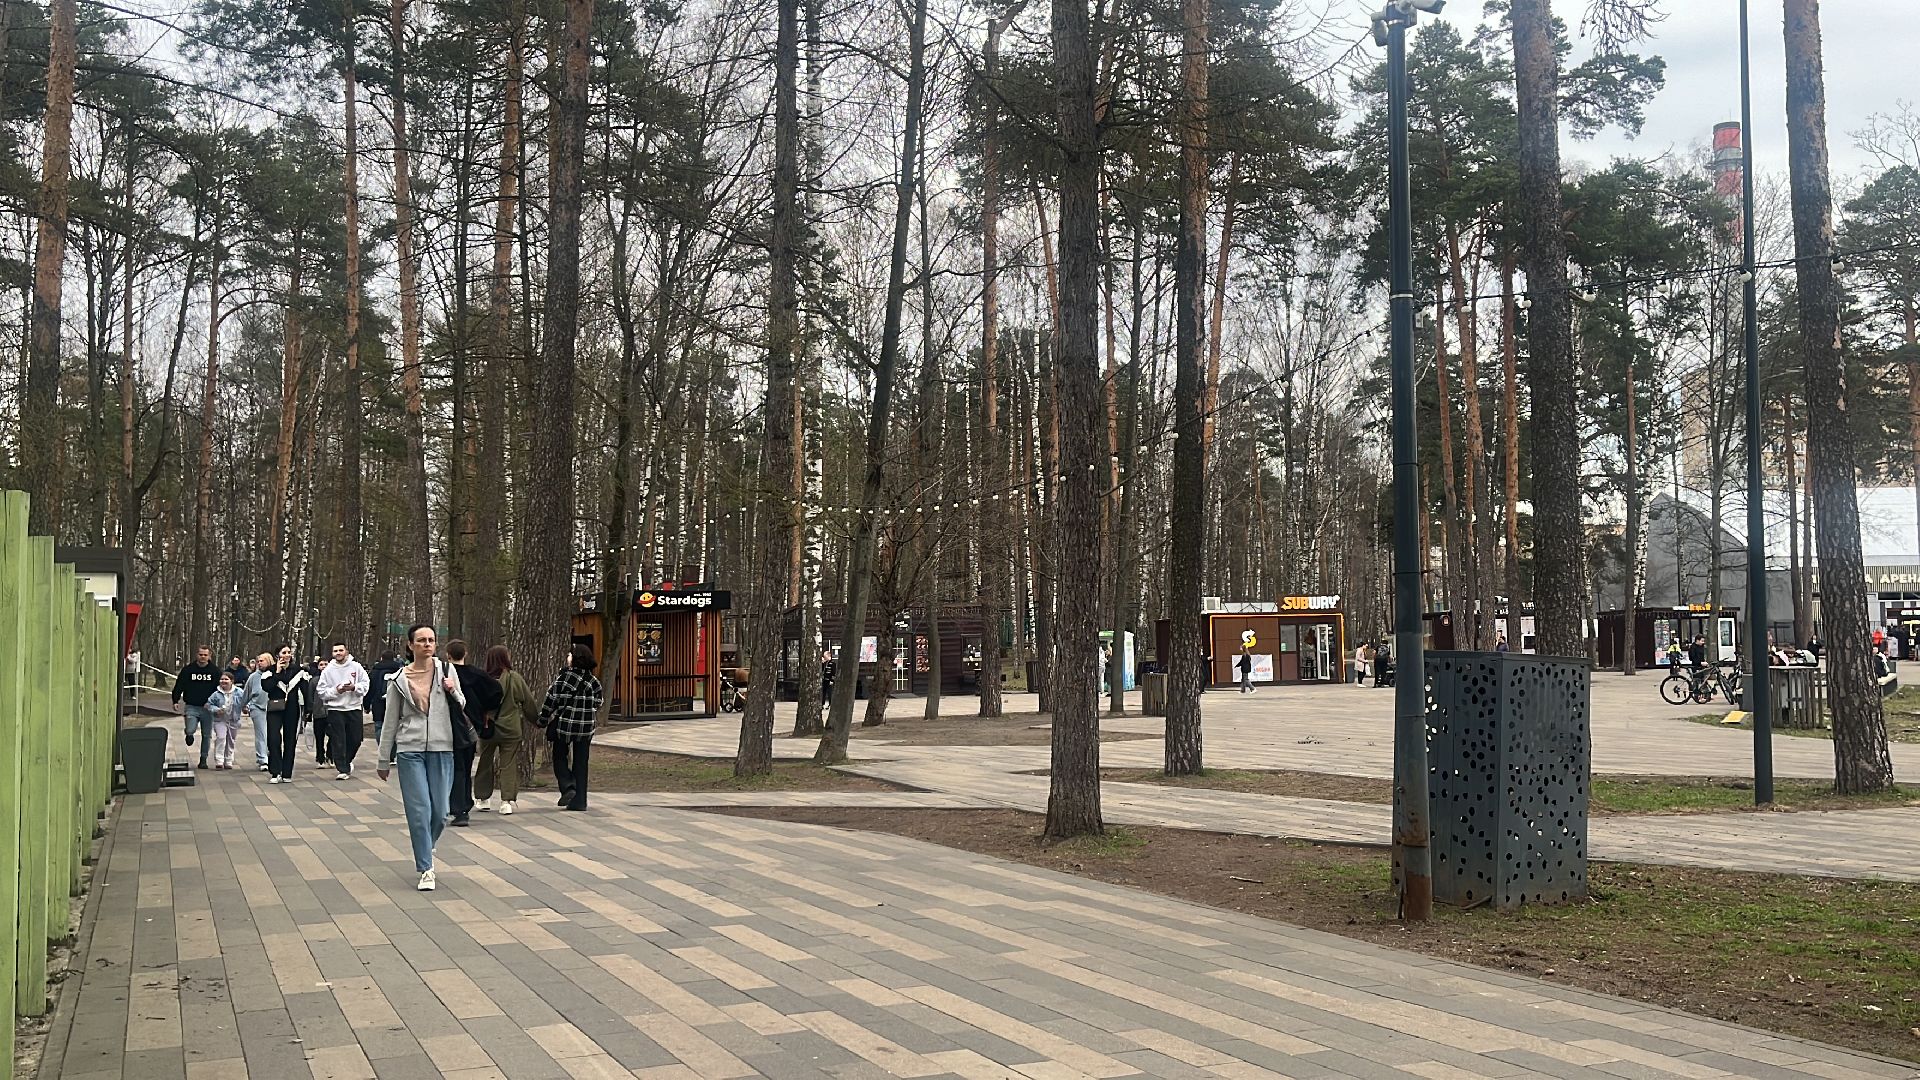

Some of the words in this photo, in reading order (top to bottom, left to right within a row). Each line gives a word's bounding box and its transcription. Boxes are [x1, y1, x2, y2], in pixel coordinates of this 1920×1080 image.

[657, 595, 712, 608] Stardogs
[1281, 594, 1340, 610] SUBWAY
[191, 673, 212, 681] BOSS
